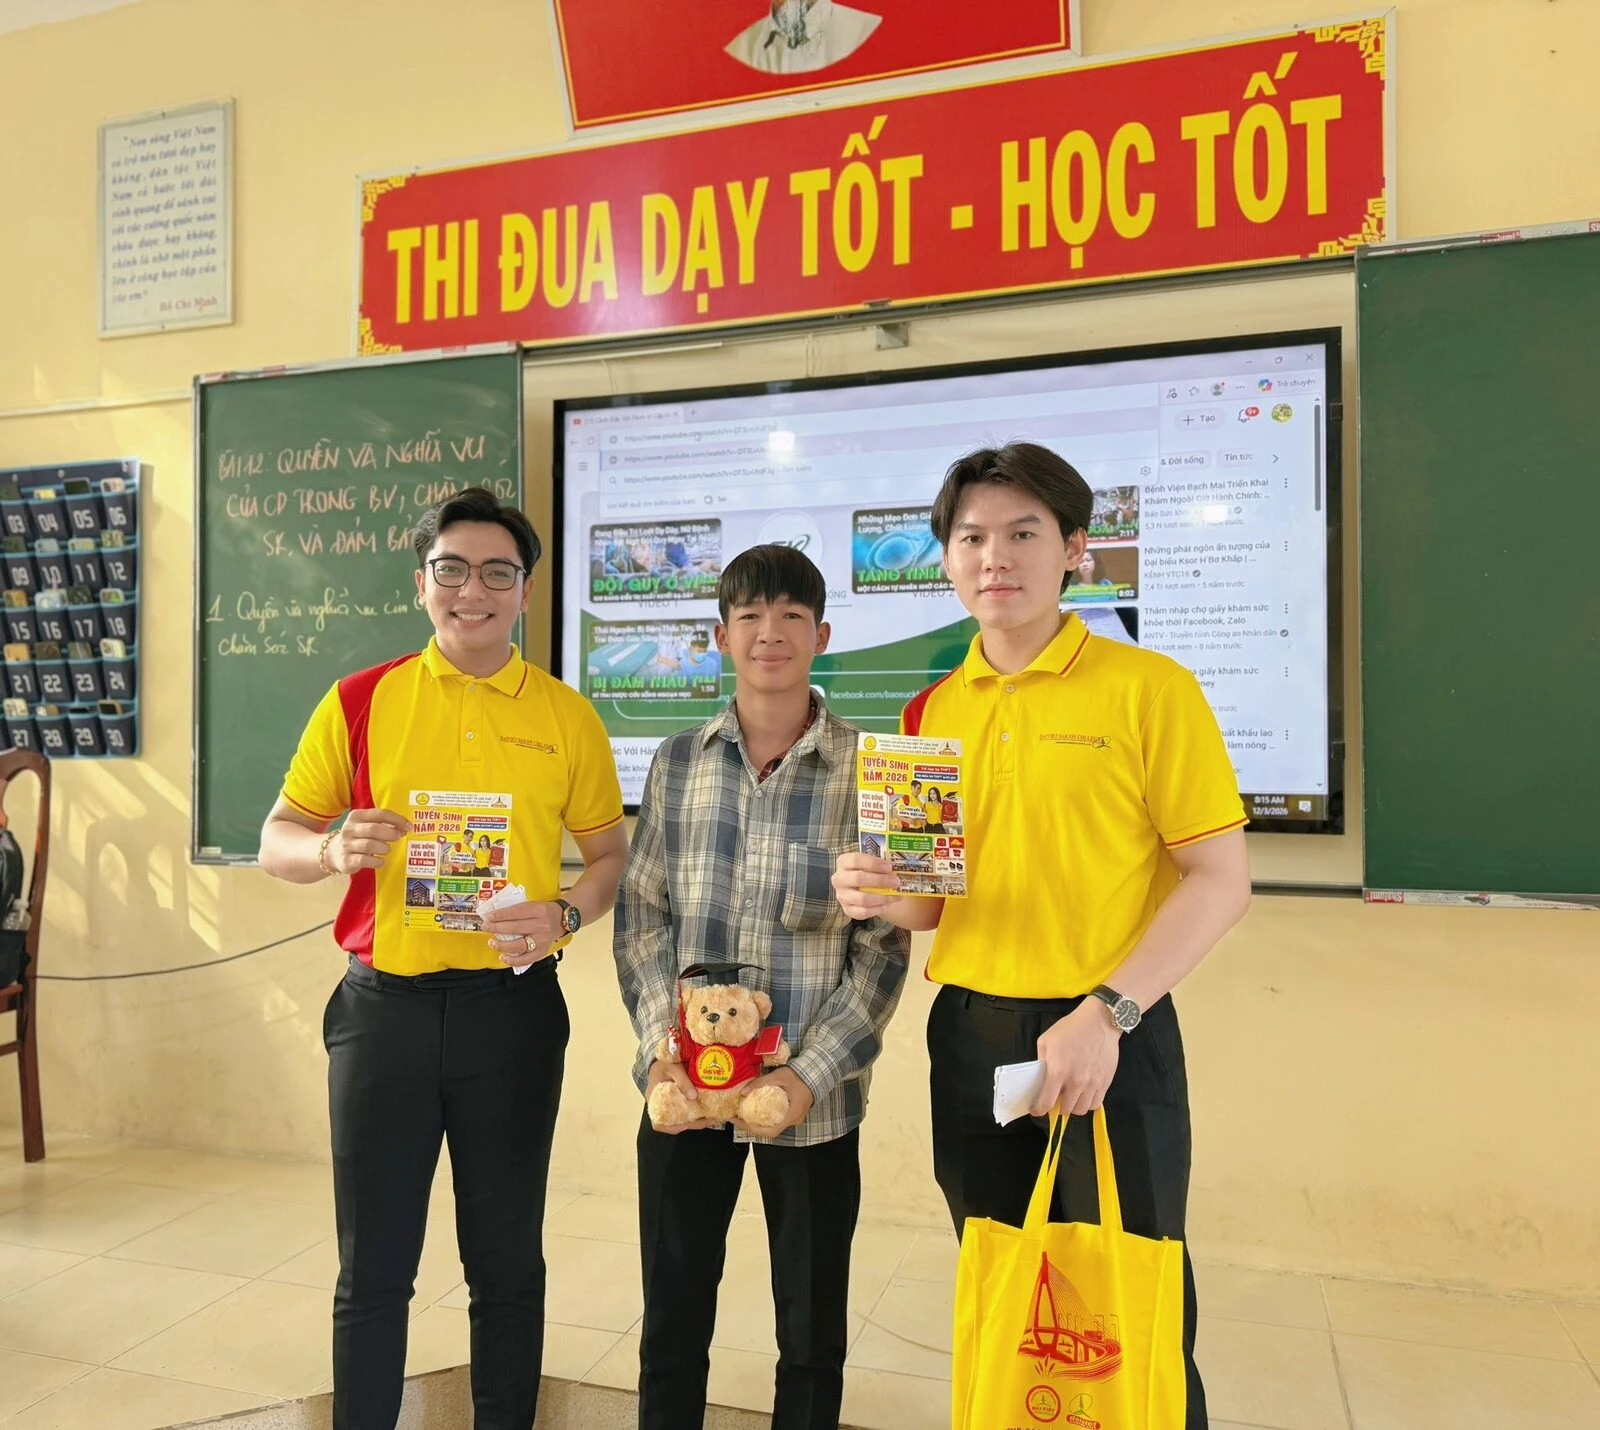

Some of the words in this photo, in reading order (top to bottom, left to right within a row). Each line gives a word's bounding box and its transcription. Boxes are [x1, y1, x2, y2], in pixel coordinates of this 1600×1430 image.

[387, 218, 479, 324] THI
[498, 201, 618, 313] ĐUA
[642, 176, 770, 314] DẠY
[790, 114, 923, 277] TỐT
[950, 204, 974, 230] -
[1001, 121, 1156, 270] HỌC
[1181, 52, 1342, 229] TỐT
[1200, 414, 1216, 422] Tạo
[1168, 456, 1182, 466] Đời
[1184, 454, 1204, 465] sống
[1145, 485, 1165, 494] Bệnh
[1168, 484, 1186, 492] Viện
[1188, 482, 1208, 491] Bạch
[1250, 478, 1268, 486] Khai
[294, 486, 358, 513] TRONG
[8, 515, 26, 534] 03
[38, 513, 58, 532] 04
[73, 509, 94, 529] 05
[108, 506, 127, 526] 06
[298, 524, 324, 556] VÀ
[1144, 546, 1170, 555] Những
[1174, 545, 1192, 554] phát
[1194, 544, 1214, 553] ngôn
[1228, 542, 1253, 552] tượng
[1255, 541, 1270, 549] của
[12, 567, 30, 586] 09
[42, 566, 62, 584] 10
[74, 564, 96, 582] 11
[109, 562, 127, 580] 12
[1169, 606, 1189, 616] nhập
[1192, 606, 1206, 614] chợ
[1208, 604, 1225, 614] giấy
[1228, 604, 1251, 612] khám
[1254, 602, 1269, 612] sức
[42, 621, 62, 639] 16
[75, 619, 93, 638] 17
[108, 617, 126, 636] 18
[1144, 618, 1164, 626] khỏe
[1184, 616, 1225, 626] Facebook,
[1228, 616, 1246, 624] Zalo
[12, 622, 30, 640] 15
[1199, 667, 1216, 678] giấy
[1218, 666, 1242, 675] khám
[1244, 666, 1260, 674] sức
[12, 674, 32, 692] 21
[42, 674, 62, 692] 22
[75, 674, 94, 692] 23
[12, 729, 28, 746] 27
[43, 729, 62, 747] 28
[74, 728, 94, 746] 29
[106, 729, 124, 747] 30
[1237, 728, 1258, 737] khẩu
[1260, 728, 1272, 736] lao
[1228, 741, 1244, 749] làm
[1246, 740, 1266, 750] nóng
[863, 754, 886, 767] TUYỂN
[890, 760, 908, 770] SINH
[864, 770, 882, 782] NĂM
[886, 772, 908, 782] 2026
[414, 808, 440, 820] TUYỂN
[442, 813, 462, 821] SINH
[414, 822, 434, 832] NĂM
[438, 824, 460, 832] 2026
